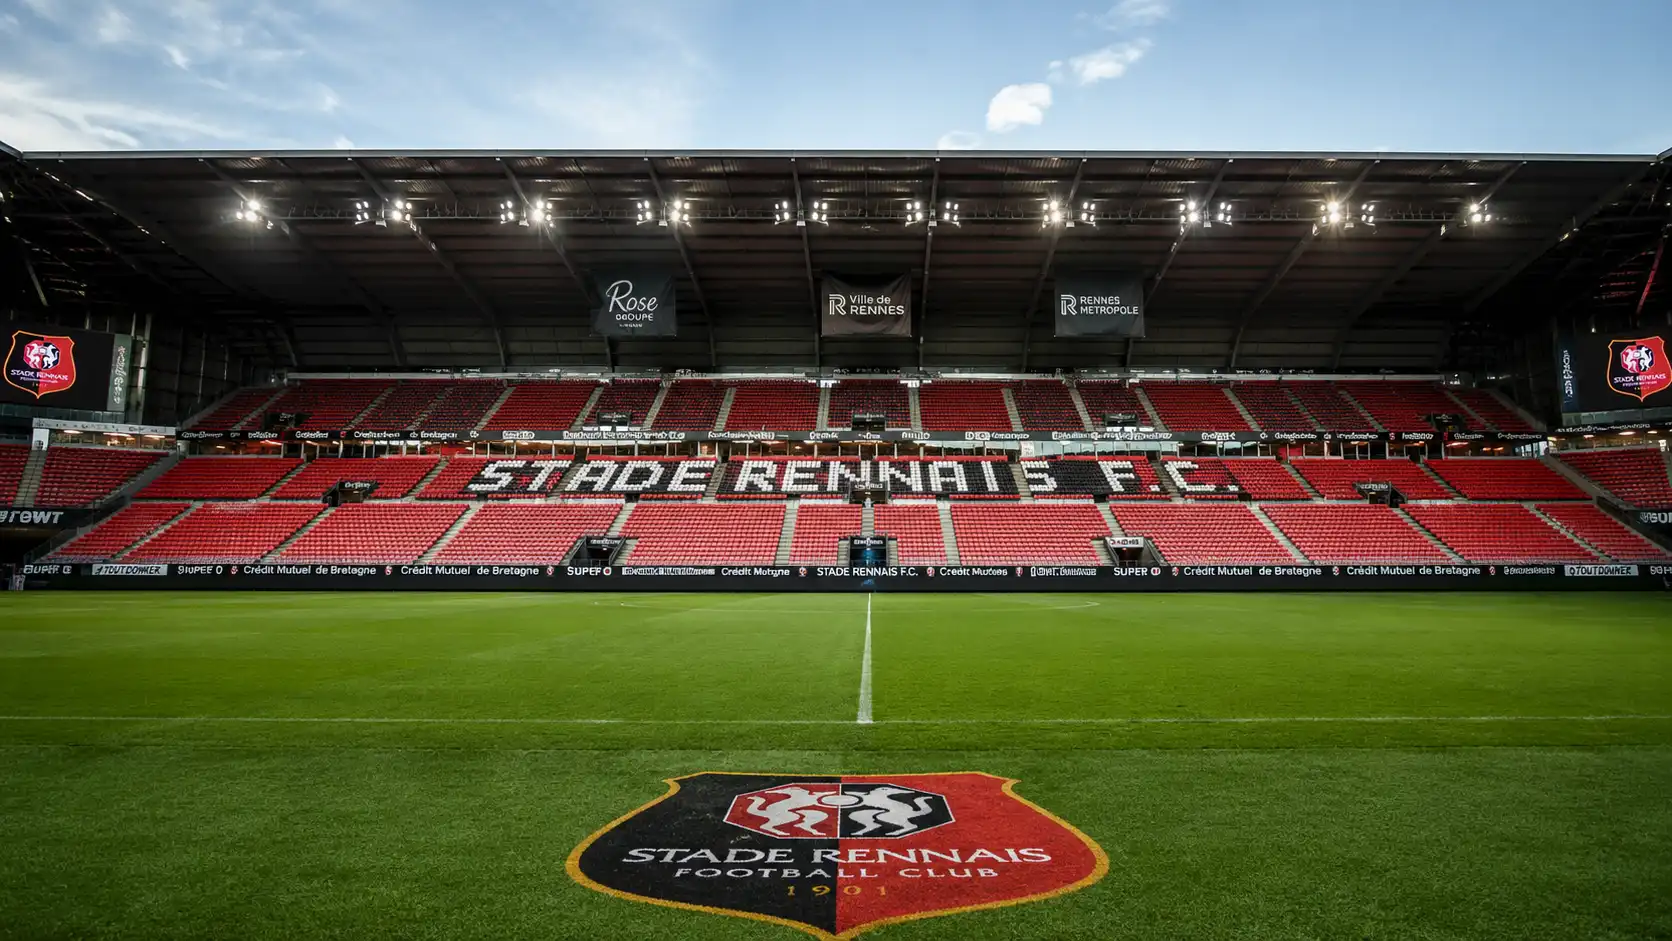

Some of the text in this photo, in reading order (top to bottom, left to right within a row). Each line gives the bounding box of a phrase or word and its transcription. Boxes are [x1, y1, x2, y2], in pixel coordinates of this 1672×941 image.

[605, 280, 659, 312] Rose
[850, 295, 891, 304] Ville de
[1080, 296, 1120, 305] RENNES
[850, 305, 905, 315] RENNES
[1080, 306, 1139, 315] METROPOLE
[468, 460, 716, 491] STADE
[276, 565, 311, 575] Mutuel
[315, 565, 328, 575] de
[435, 566, 470, 575] Mutuel
[477, 566, 490, 575] de
[816, 567, 919, 576] STADE RENNAIS F.C.
[1113, 567, 1148, 576] SUPER
[1217, 567, 1253, 576] Mutuel
[1258, 566, 1272, 576] de
[1380, 566, 1415, 575] Mutuel
[1419, 566, 1432, 575] de
[1434, 566, 1481, 576] Bretagne
[622, 848, 1051, 864] STADE RENNAIS
[674, 867, 999, 879] FOOTBALL CLUB
[786, 884, 888, 897] 1901
